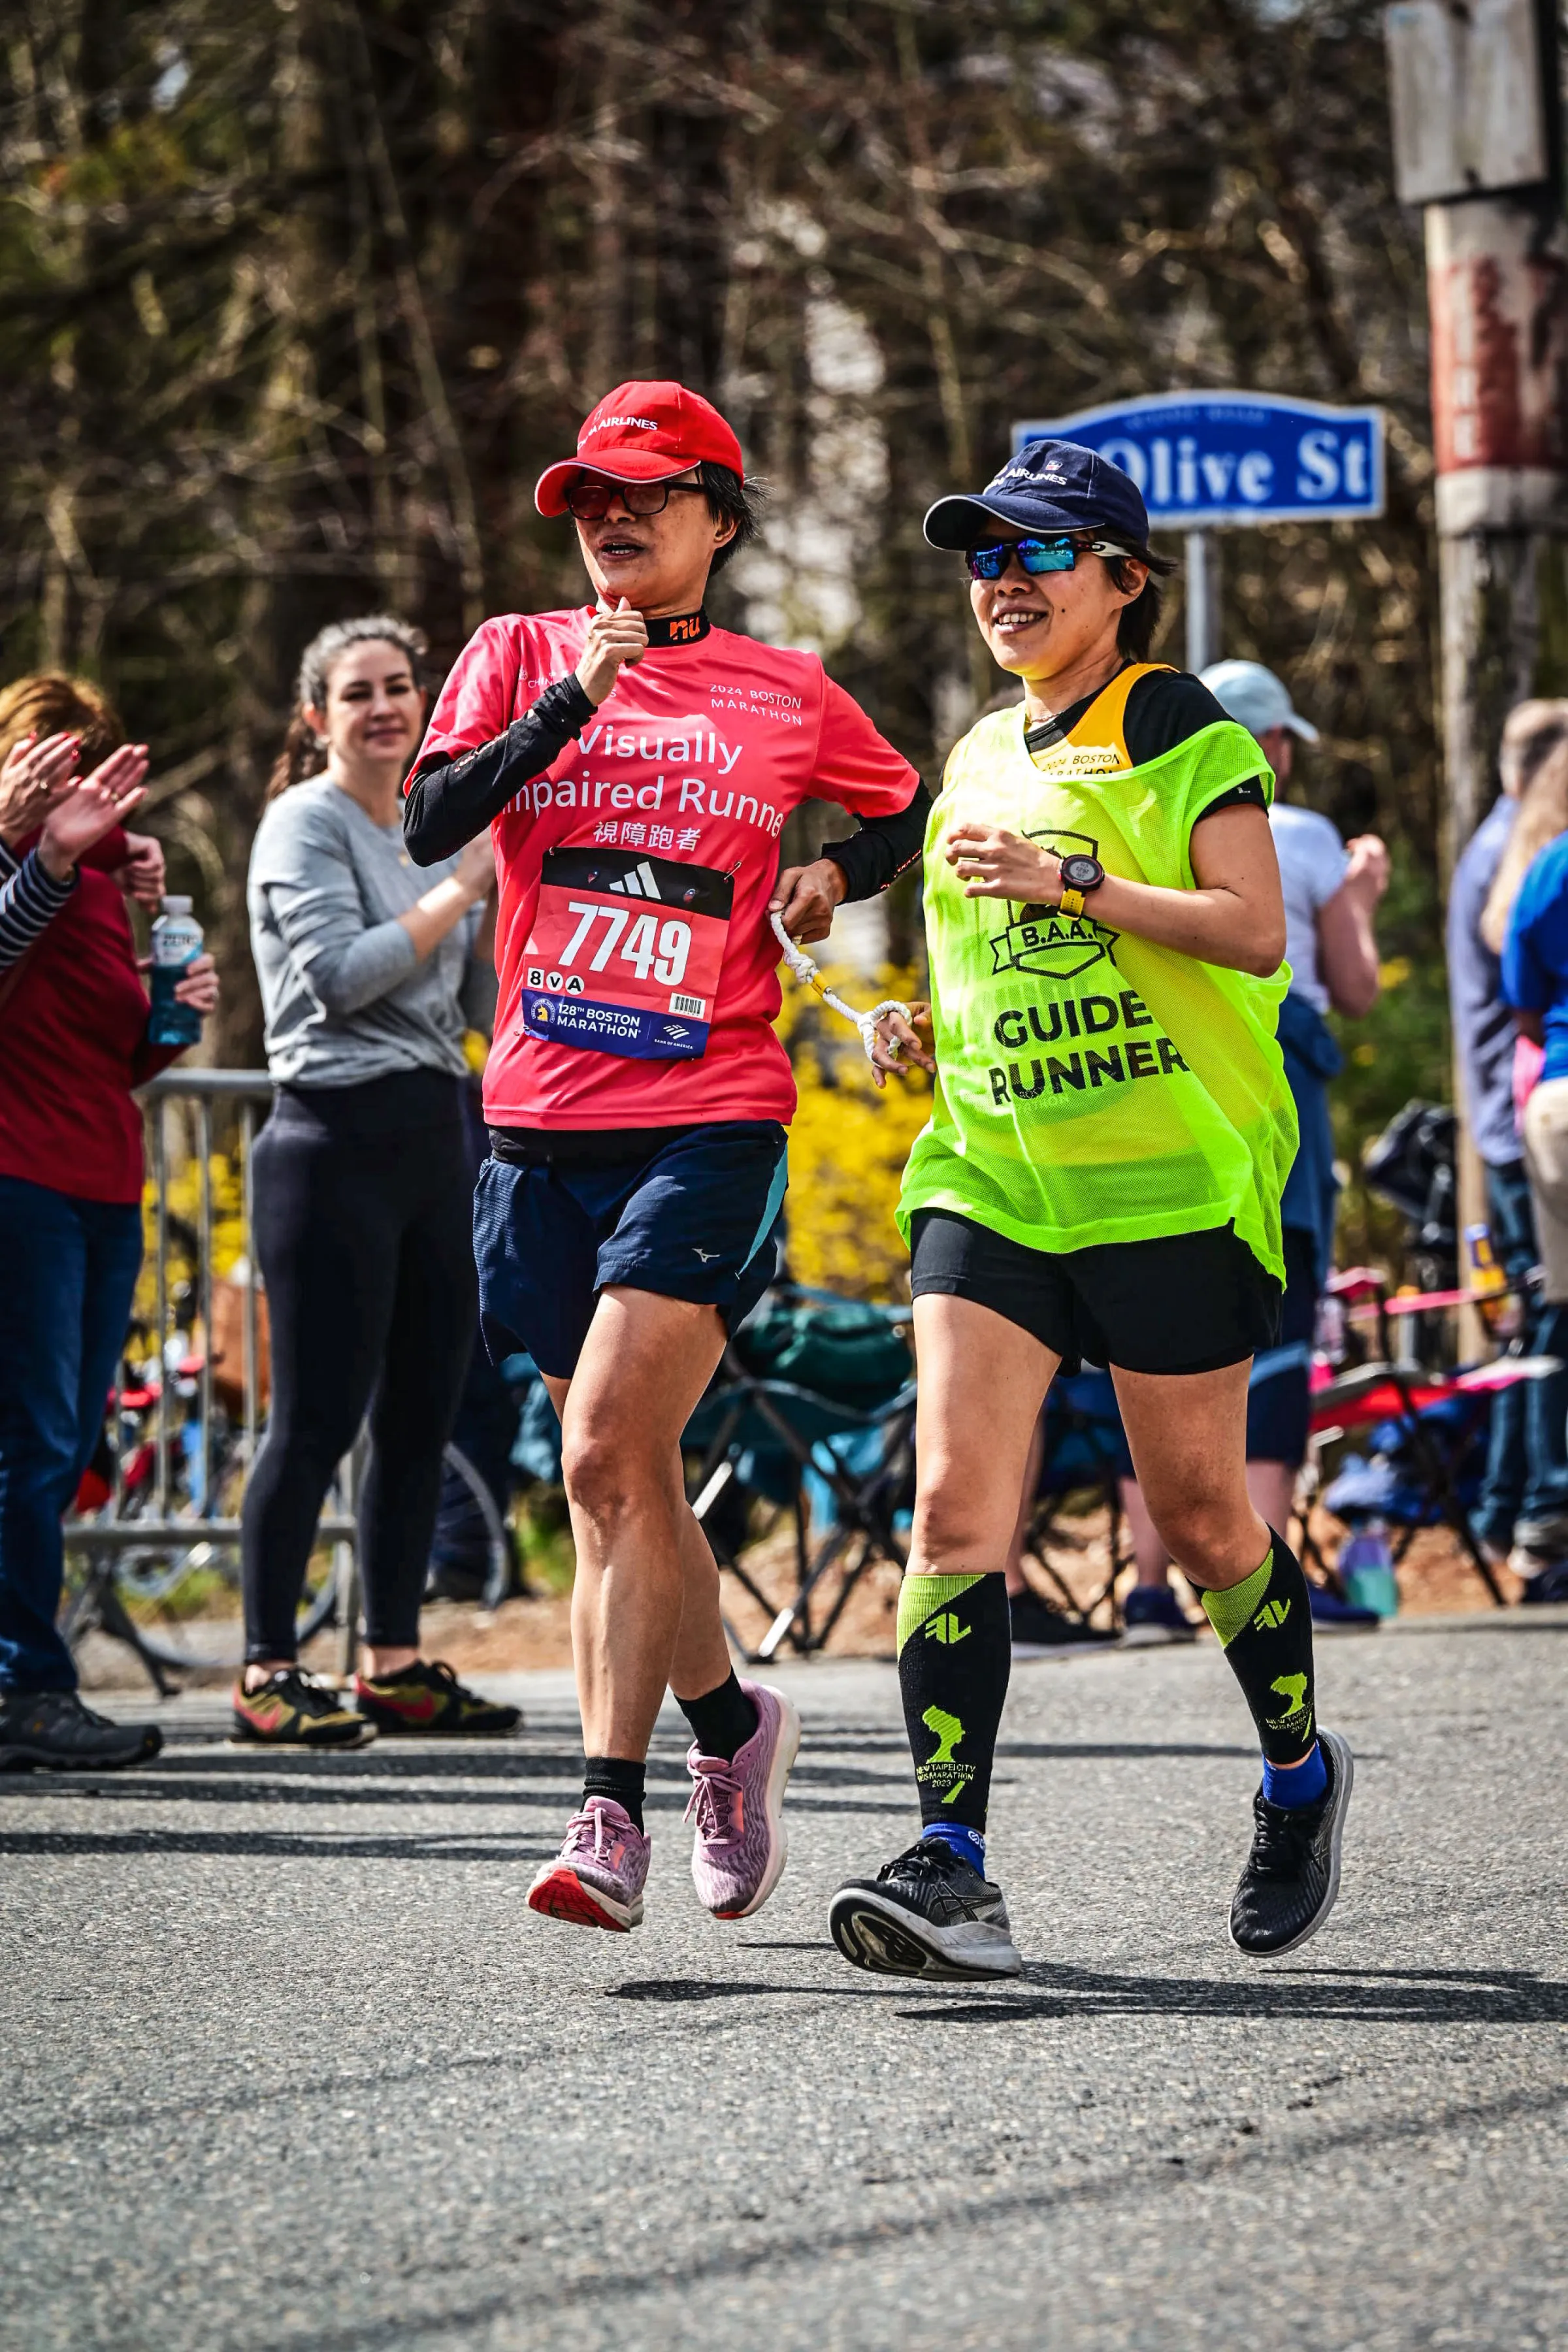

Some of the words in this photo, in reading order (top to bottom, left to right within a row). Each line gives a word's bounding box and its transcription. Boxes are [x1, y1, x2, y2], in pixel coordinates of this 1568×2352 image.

[598, 416, 658, 431] AIRLINES
[1005, 468, 1068, 485] AIRLINES
[1097, 436, 1274, 504] Olive
[1296, 429, 1369, 501] St
[710, 684, 743, 696] 2024
[750, 690, 802, 710] BOSTON
[711, 698, 802, 727] MARATHON
[578, 724, 743, 775] Visually
[1072, 753, 1120, 765] BOSTON
[502, 771, 664, 820] mpaired
[678, 778, 785, 839] Runne
[593, 820, 702, 852] 視障跑者
[557, 901, 692, 987] 7749
[1021, 921, 1093, 948] B.A.A.
[530, 970, 541, 986] 8
[567, 977, 581, 992] A
[586, 1008, 641, 1027] BOSTON
[994, 989, 1154, 1049] GUIDE
[988, 1037, 1191, 1105] RUNNER
[929, 1771, 973, 1781] MARATHON
[930, 1763, 956, 1772] TAIPEI
[956, 1763, 976, 1773] CITY
[932, 1779, 951, 1788] 2023
